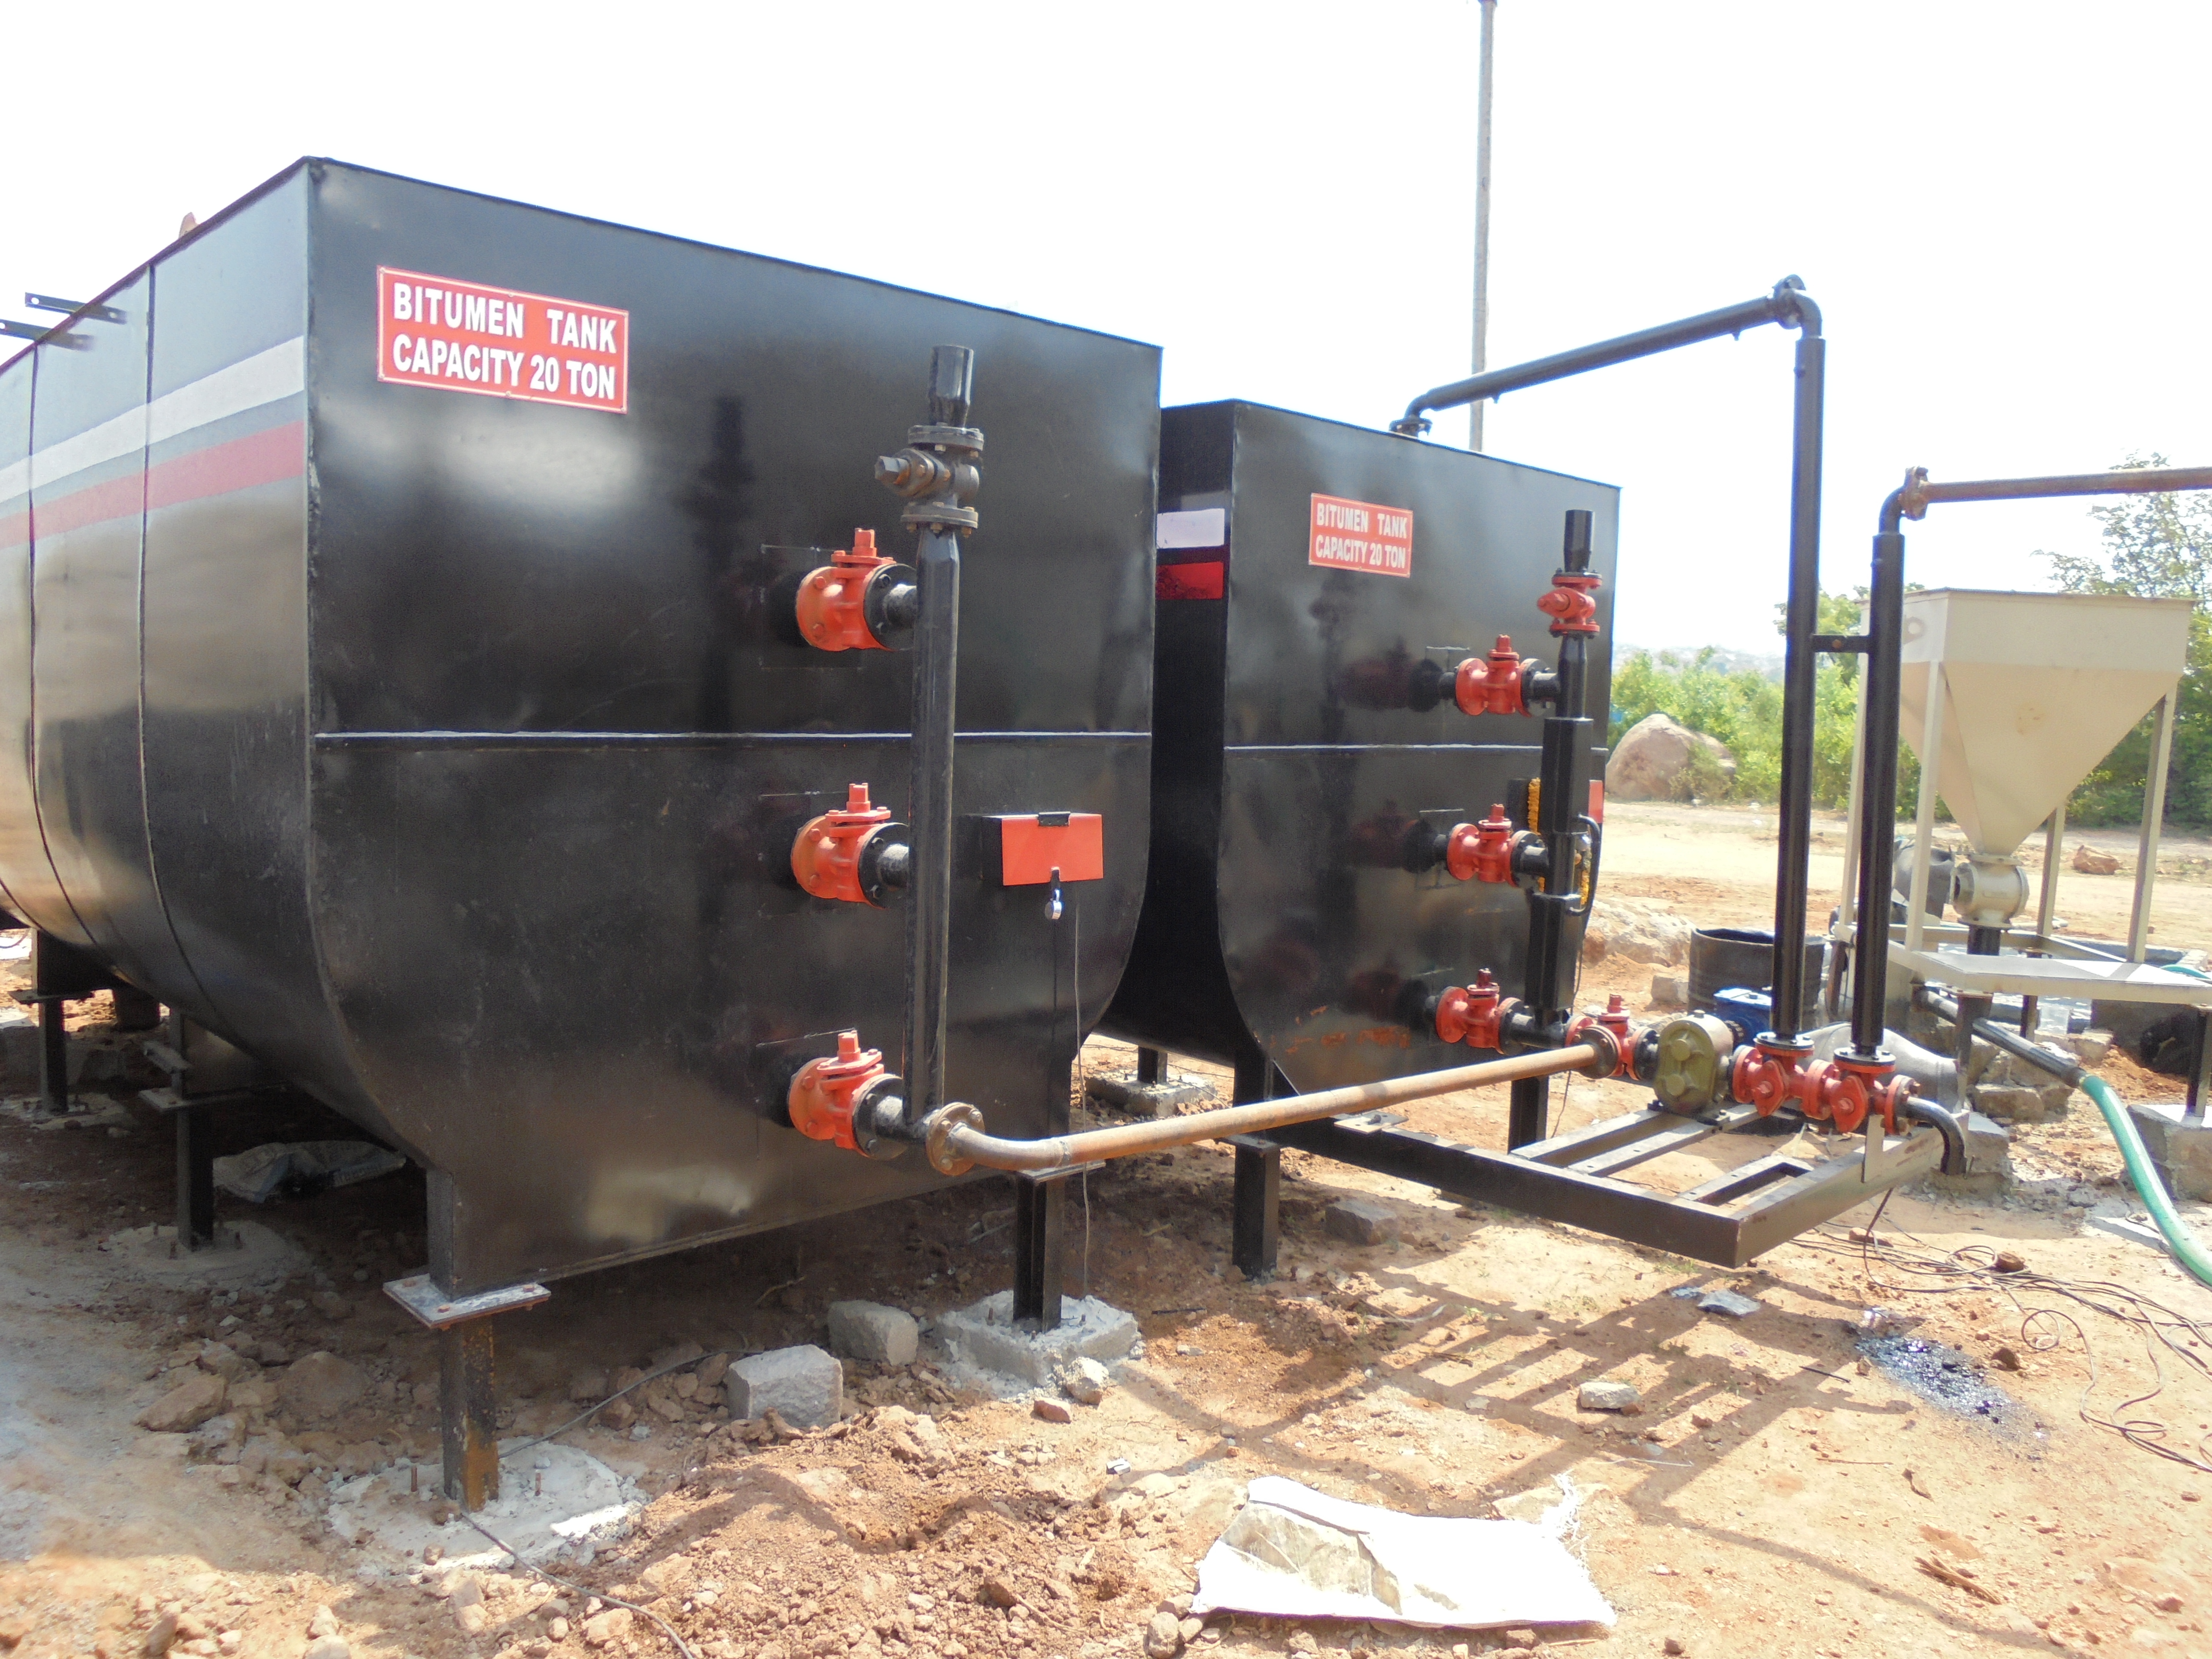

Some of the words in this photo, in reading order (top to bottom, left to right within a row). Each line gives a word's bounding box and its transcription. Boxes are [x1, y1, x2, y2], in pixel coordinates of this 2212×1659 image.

[394, 282, 524, 338] BITUMEN
[547, 308, 617, 353] TANK
[393, 334, 525, 386] CAPACITY
[530, 355, 559, 392] 20
[566, 360, 615, 400] TON
[1317, 503, 1369, 533] BITUMEN
[1377, 513, 1408, 538] TANK
[1316, 535, 1368, 563] CAPACITY
[1369, 542, 1382, 566] 20
[1385, 545, 1406, 568] TON
